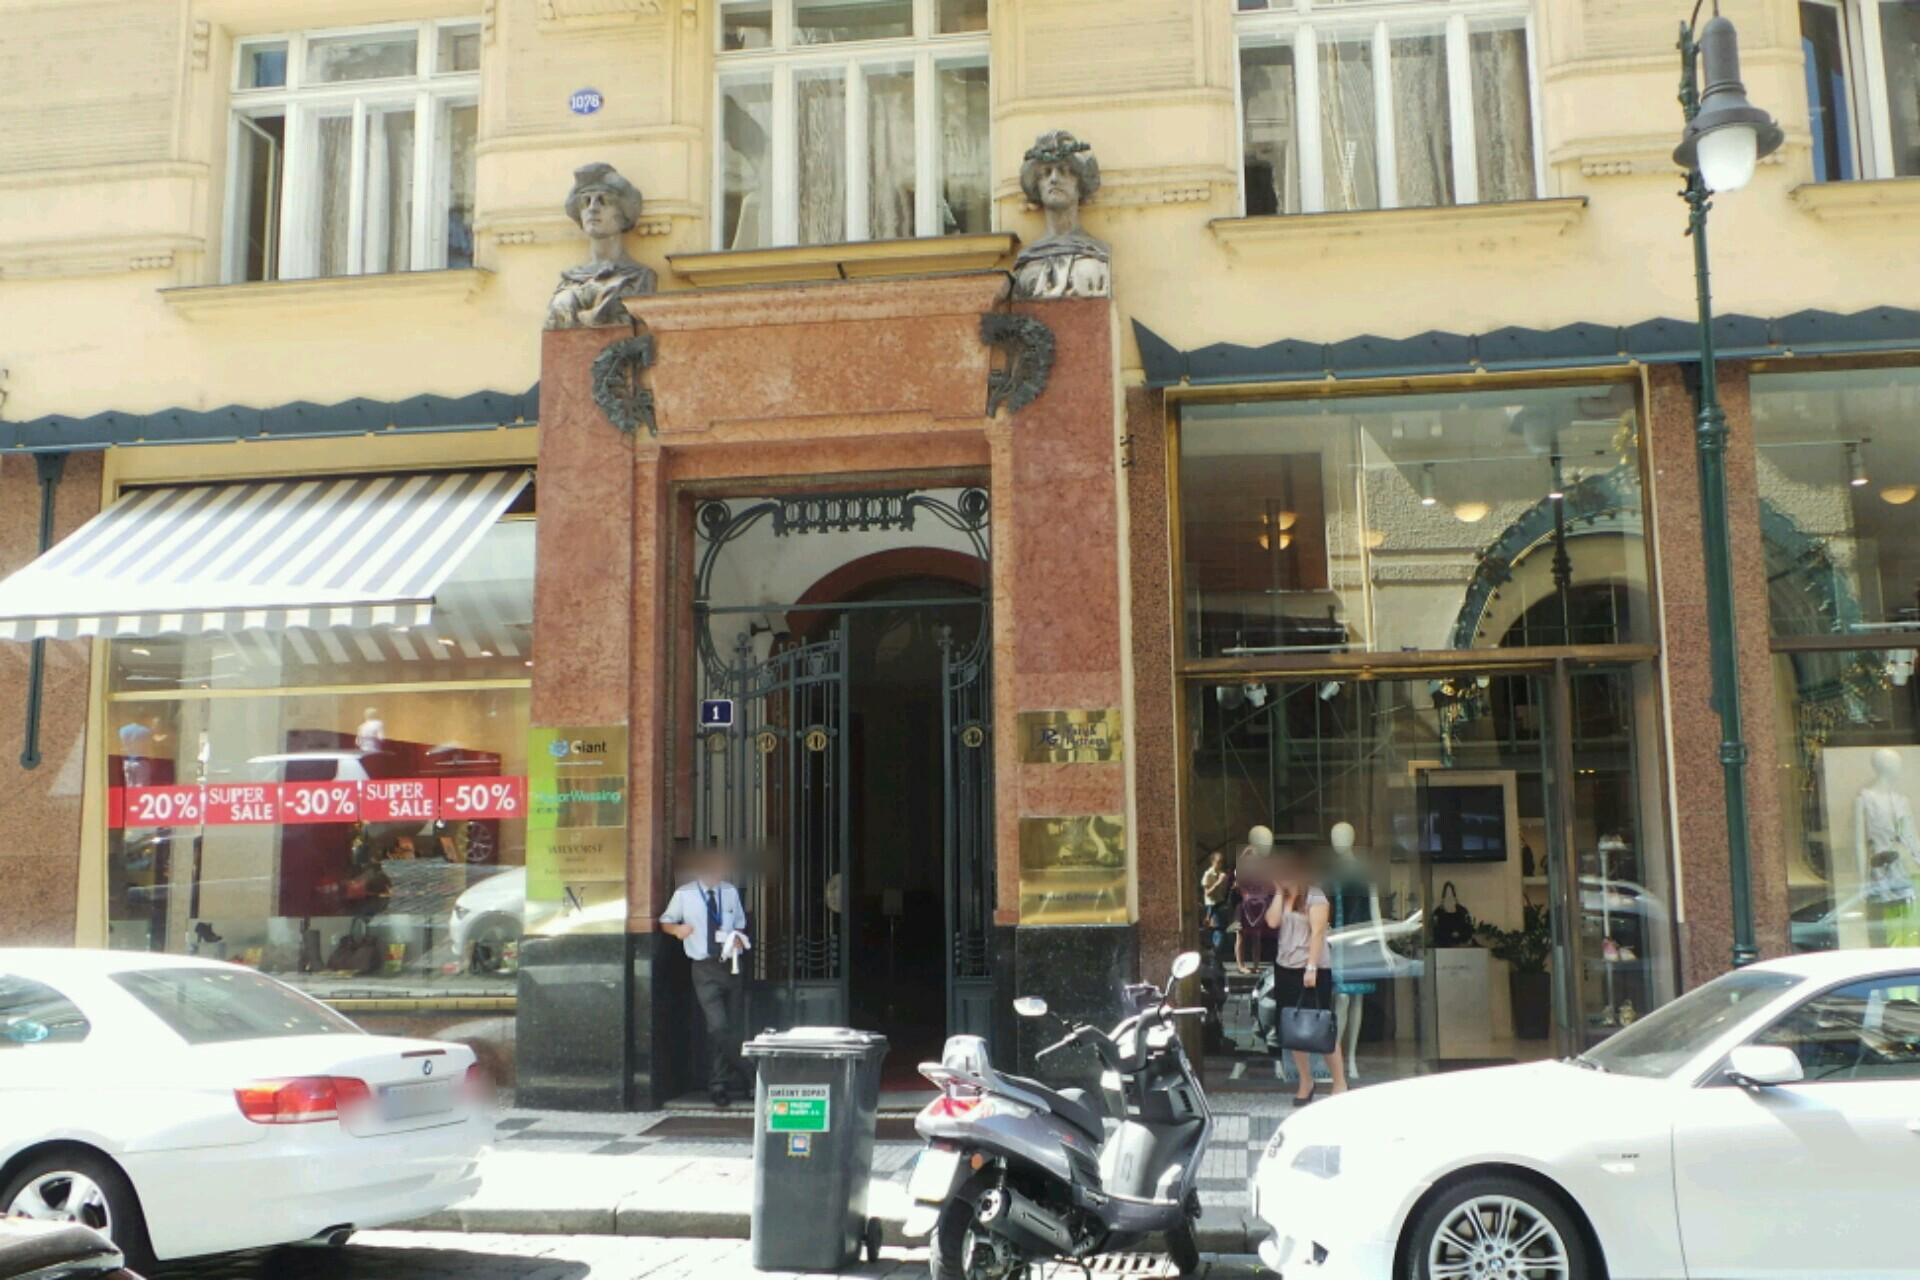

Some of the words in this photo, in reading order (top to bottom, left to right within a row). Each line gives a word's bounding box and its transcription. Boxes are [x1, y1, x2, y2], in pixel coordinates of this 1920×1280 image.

[712, 704, 720, 720] 1
[570, 739, 608, 754] Giant
[208, 787, 265, 805] SUPER
[366, 782, 424, 800] SUPER
[445, 784, 516, 812] -50%
[533, 789, 622, 805] orWessing
[129, 793, 199, 820] -20%
[284, 788, 355, 816] -30%
[388, 799, 433, 817] SALE
[230, 803, 274, 821] SALE
